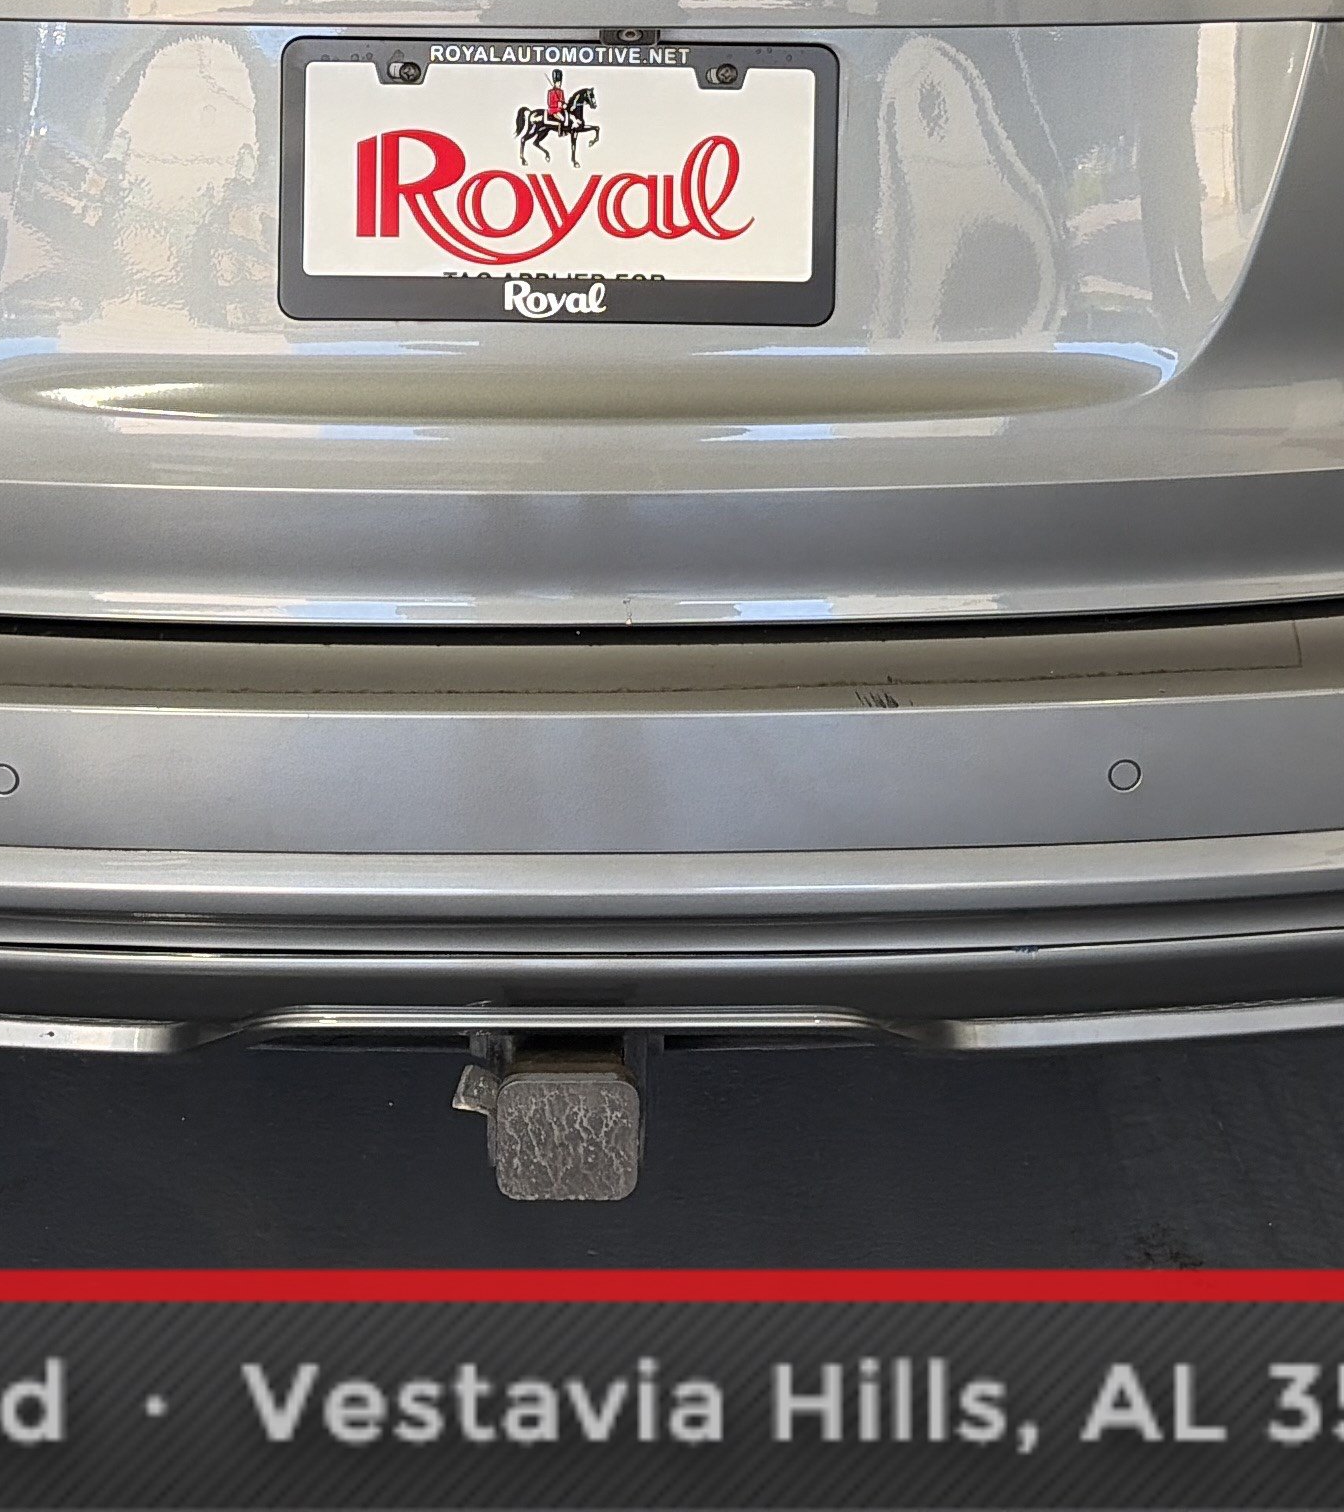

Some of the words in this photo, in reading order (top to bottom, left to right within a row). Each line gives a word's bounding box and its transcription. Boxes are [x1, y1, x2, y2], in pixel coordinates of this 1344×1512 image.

[429, 44, 691, 66] ROYALAUTOMOTIVE.NET
[355, 128, 756, 266] Royal
[504, 280, 607, 319] Royal
